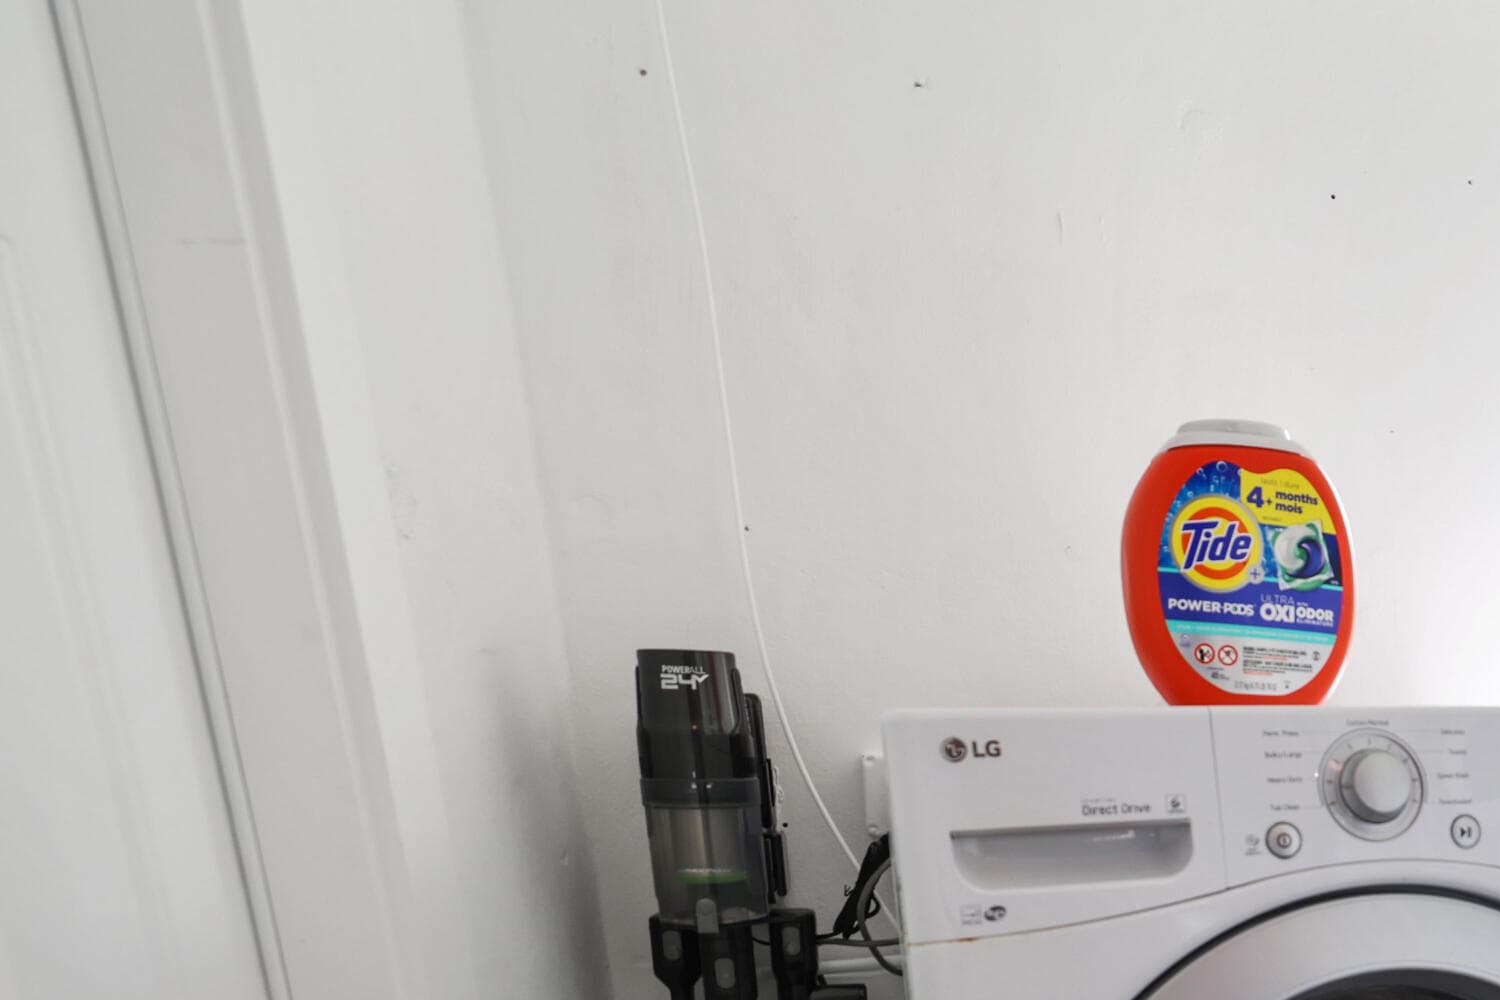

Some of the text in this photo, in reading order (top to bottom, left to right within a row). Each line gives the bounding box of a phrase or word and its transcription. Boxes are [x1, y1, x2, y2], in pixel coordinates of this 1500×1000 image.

[1275, 491, 1318, 506] months
[1275, 503, 1303, 514] mois
[1181, 520, 1252, 570] Tide
[1260, 593, 1295, 605] ULTRA
[1260, 603, 1296, 624] OXI
[1296, 606, 1334, 622] ODOR
[661, 664, 706, 675] POWERALL
[971, 739, 1001, 758] LG
[1081, 803, 1151, 816] Direct Drive
